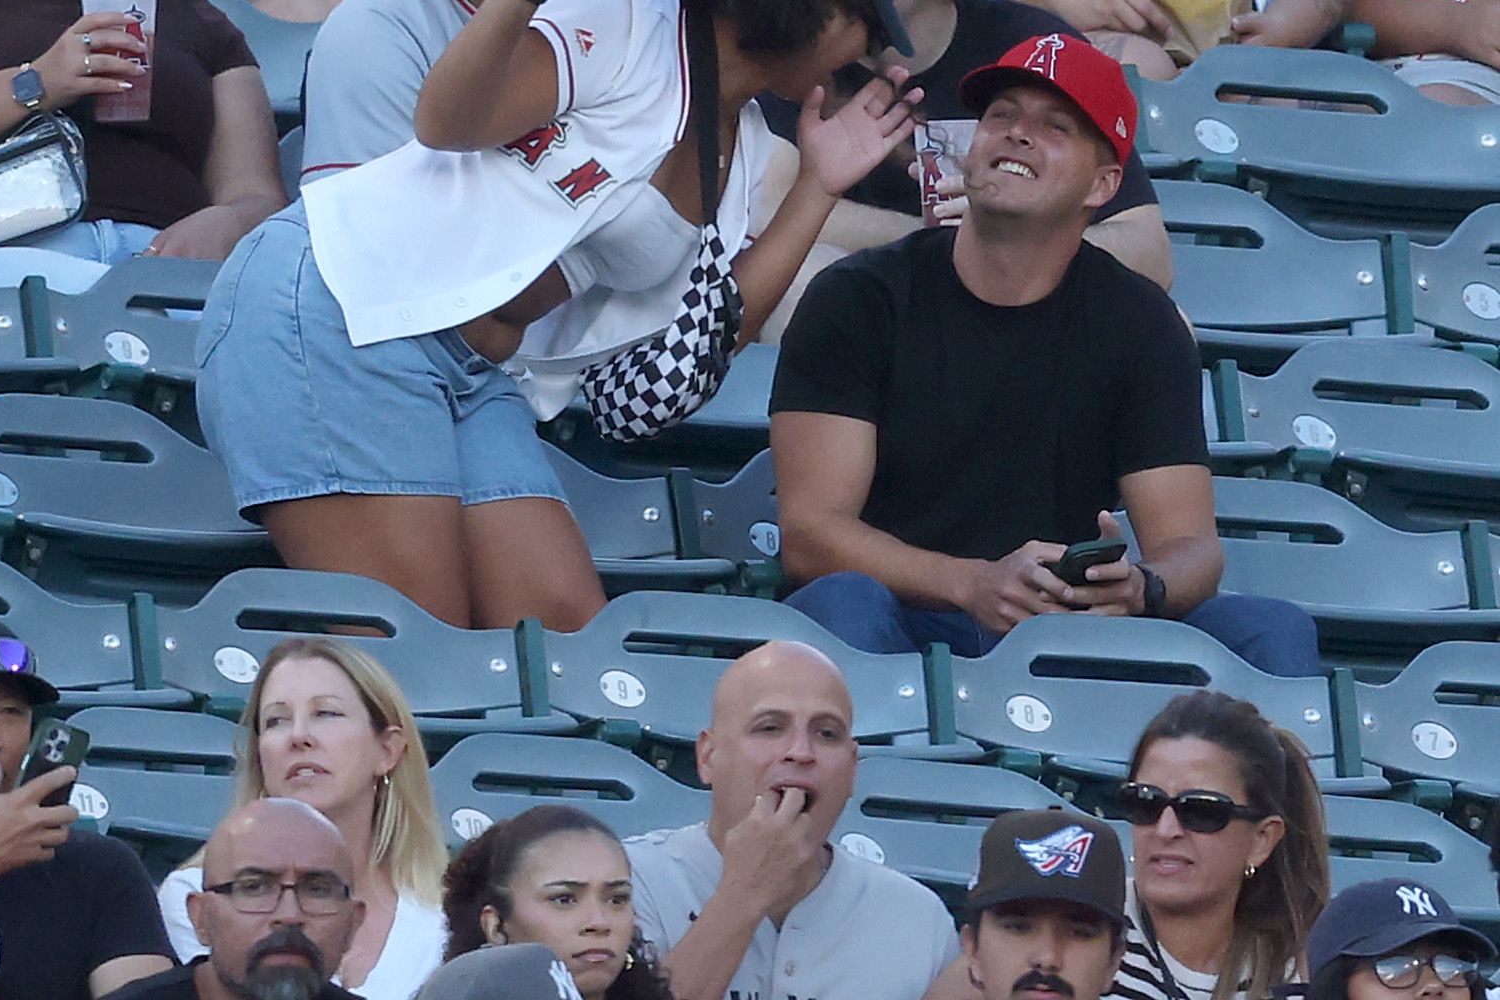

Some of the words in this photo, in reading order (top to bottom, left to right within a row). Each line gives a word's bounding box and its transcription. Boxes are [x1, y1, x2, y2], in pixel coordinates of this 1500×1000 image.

[1023, 34, 1065, 81] A
[617, 679, 628, 700] 9
[1429, 731, 1438, 751] 7
[77, 792, 94, 814] 11
[1396, 886, 1438, 916] NY
